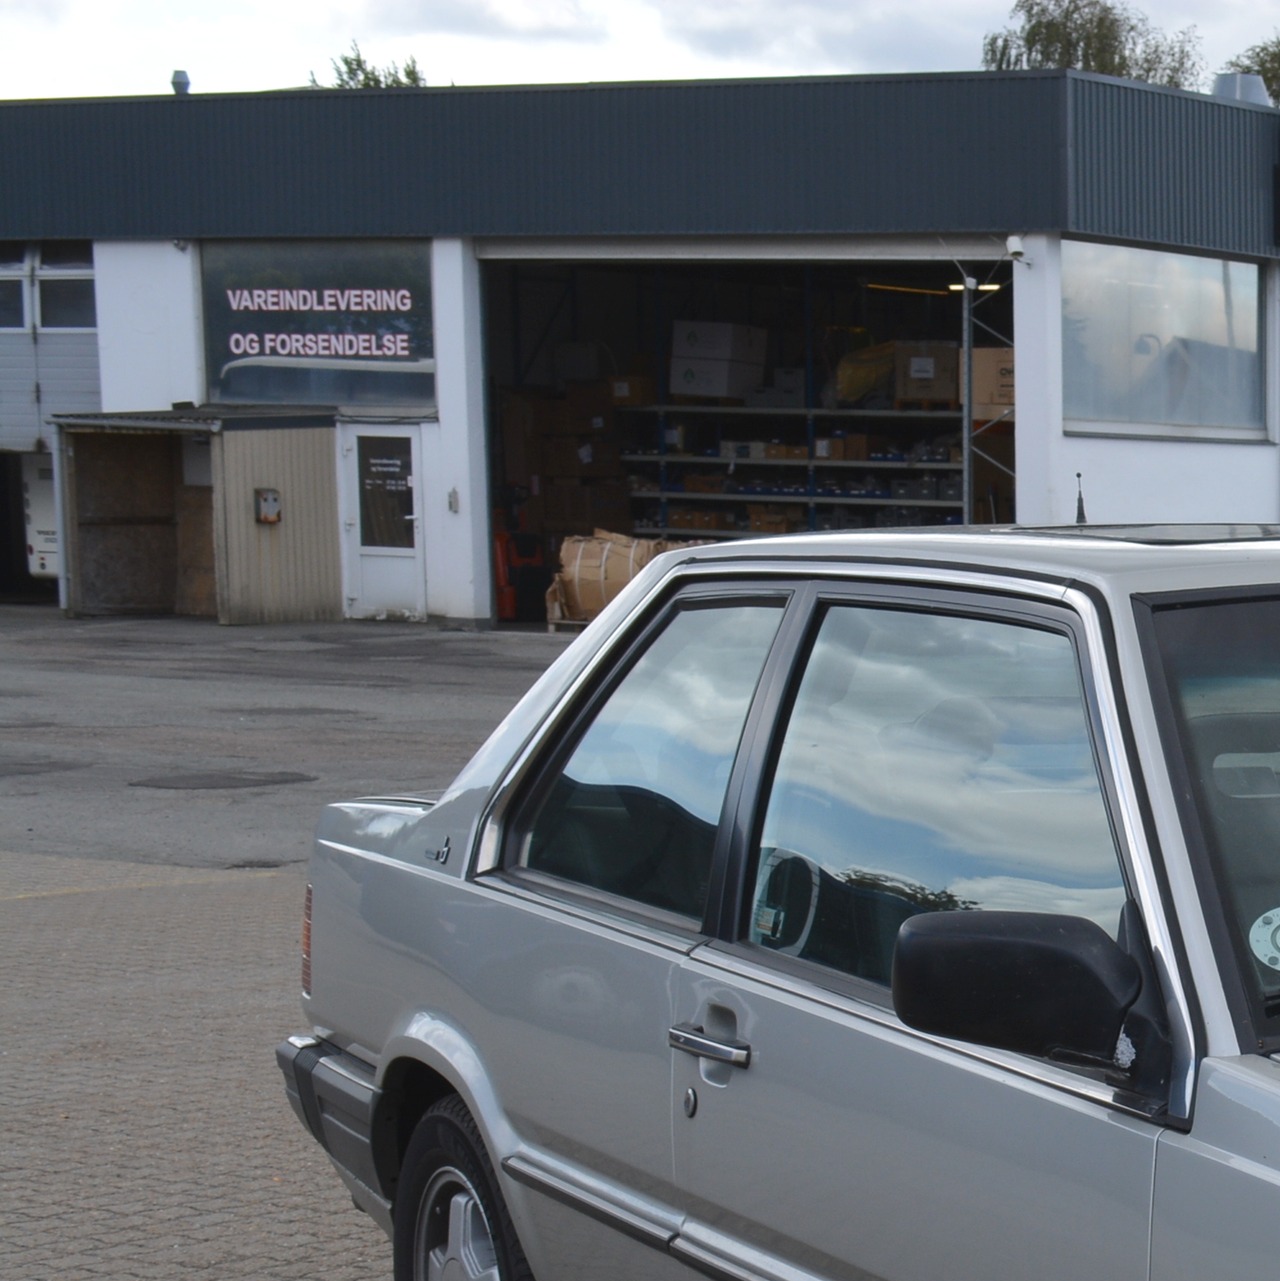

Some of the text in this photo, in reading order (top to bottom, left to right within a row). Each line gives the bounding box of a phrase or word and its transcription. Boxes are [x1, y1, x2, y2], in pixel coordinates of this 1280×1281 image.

[226, 288, 413, 312] VAREINDLEVERING
[229, 332, 410, 356] OG FORSENDELSE
